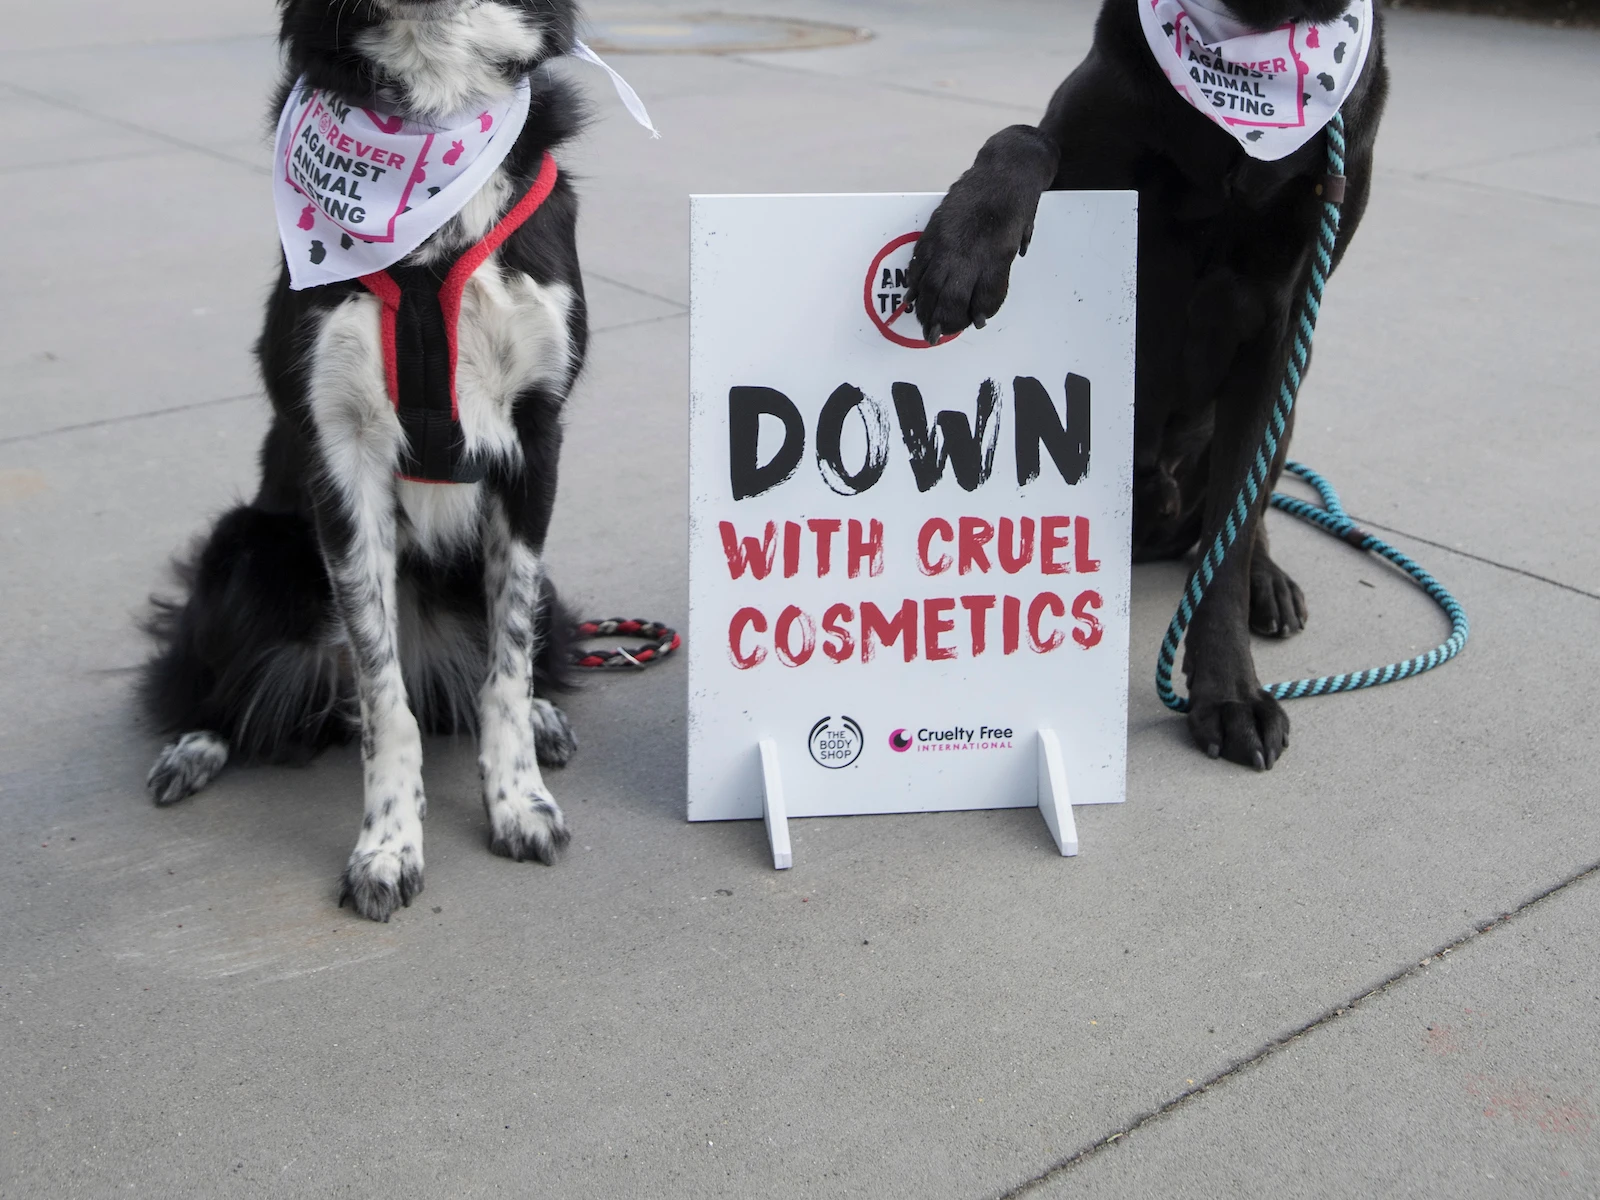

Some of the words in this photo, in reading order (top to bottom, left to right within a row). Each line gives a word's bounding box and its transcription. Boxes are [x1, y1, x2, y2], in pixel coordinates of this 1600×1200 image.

[1189, 66, 1266, 98] ANIMAL
[301, 124, 387, 182] AGAINST
[312, 101, 406, 170] FOREVER
[292, 161, 367, 224] TESTING
[293, 144, 363, 201] ANIMAL
[881, 268, 909, 289] AN
[729, 372, 1091, 501] DOWN
[719, 517, 885, 580] WITH
[917, 515, 1101, 577] CRUEL
[728, 589, 1105, 670] COSMETICS
[820, 739, 853, 750] BODY
[820, 749, 852, 760] SHOP
[826, 730, 847, 740] THE
[917, 726, 974, 743] Cruelty
[980, 726, 1014, 740] Free
[917, 741, 1014, 752] INTERNATIONAL
